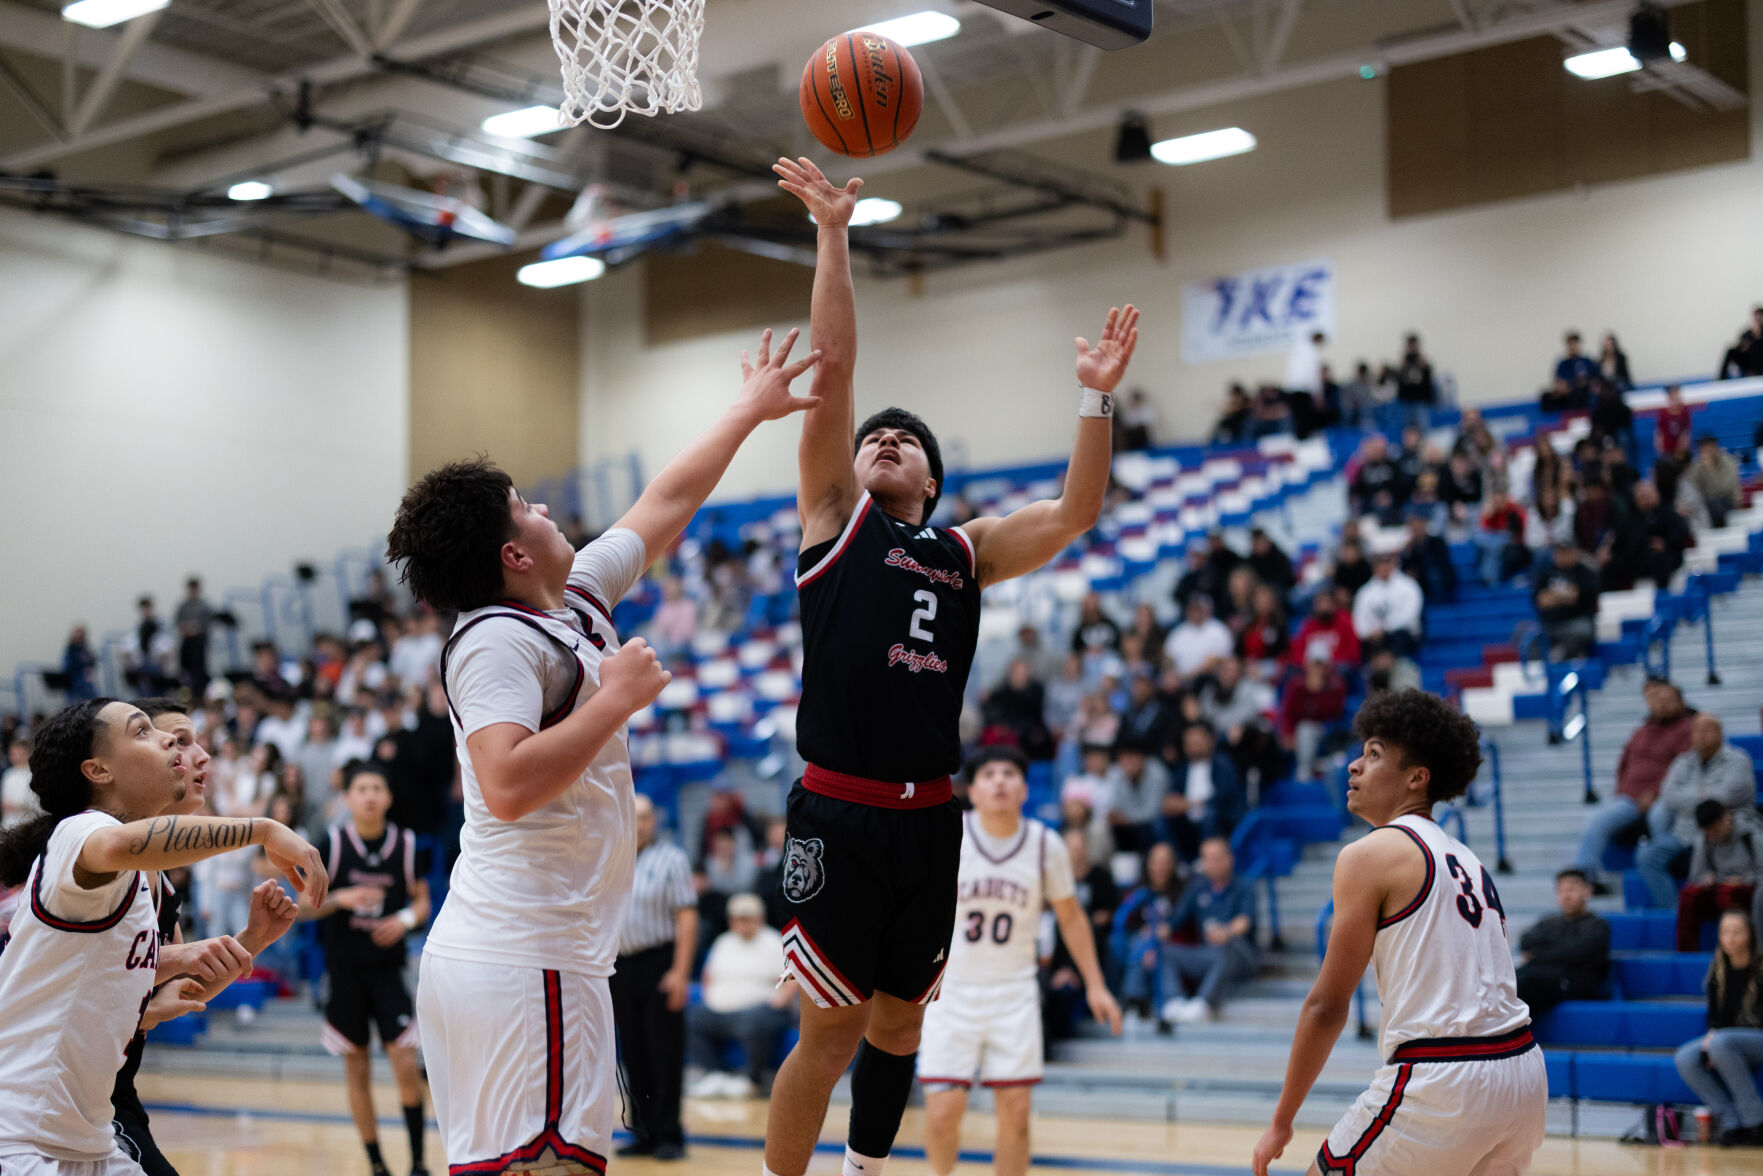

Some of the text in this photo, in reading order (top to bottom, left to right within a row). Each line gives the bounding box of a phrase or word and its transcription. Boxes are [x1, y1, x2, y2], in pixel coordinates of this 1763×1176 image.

[885, 548, 963, 589] Sunnyside
[909, 589, 938, 643] 2
[888, 643, 947, 673] Grizzlies
[129, 814, 264, 856] Pleasant
[1445, 853, 1506, 938] 34
[966, 911, 1013, 944] 30
[126, 929, 161, 970] CA
